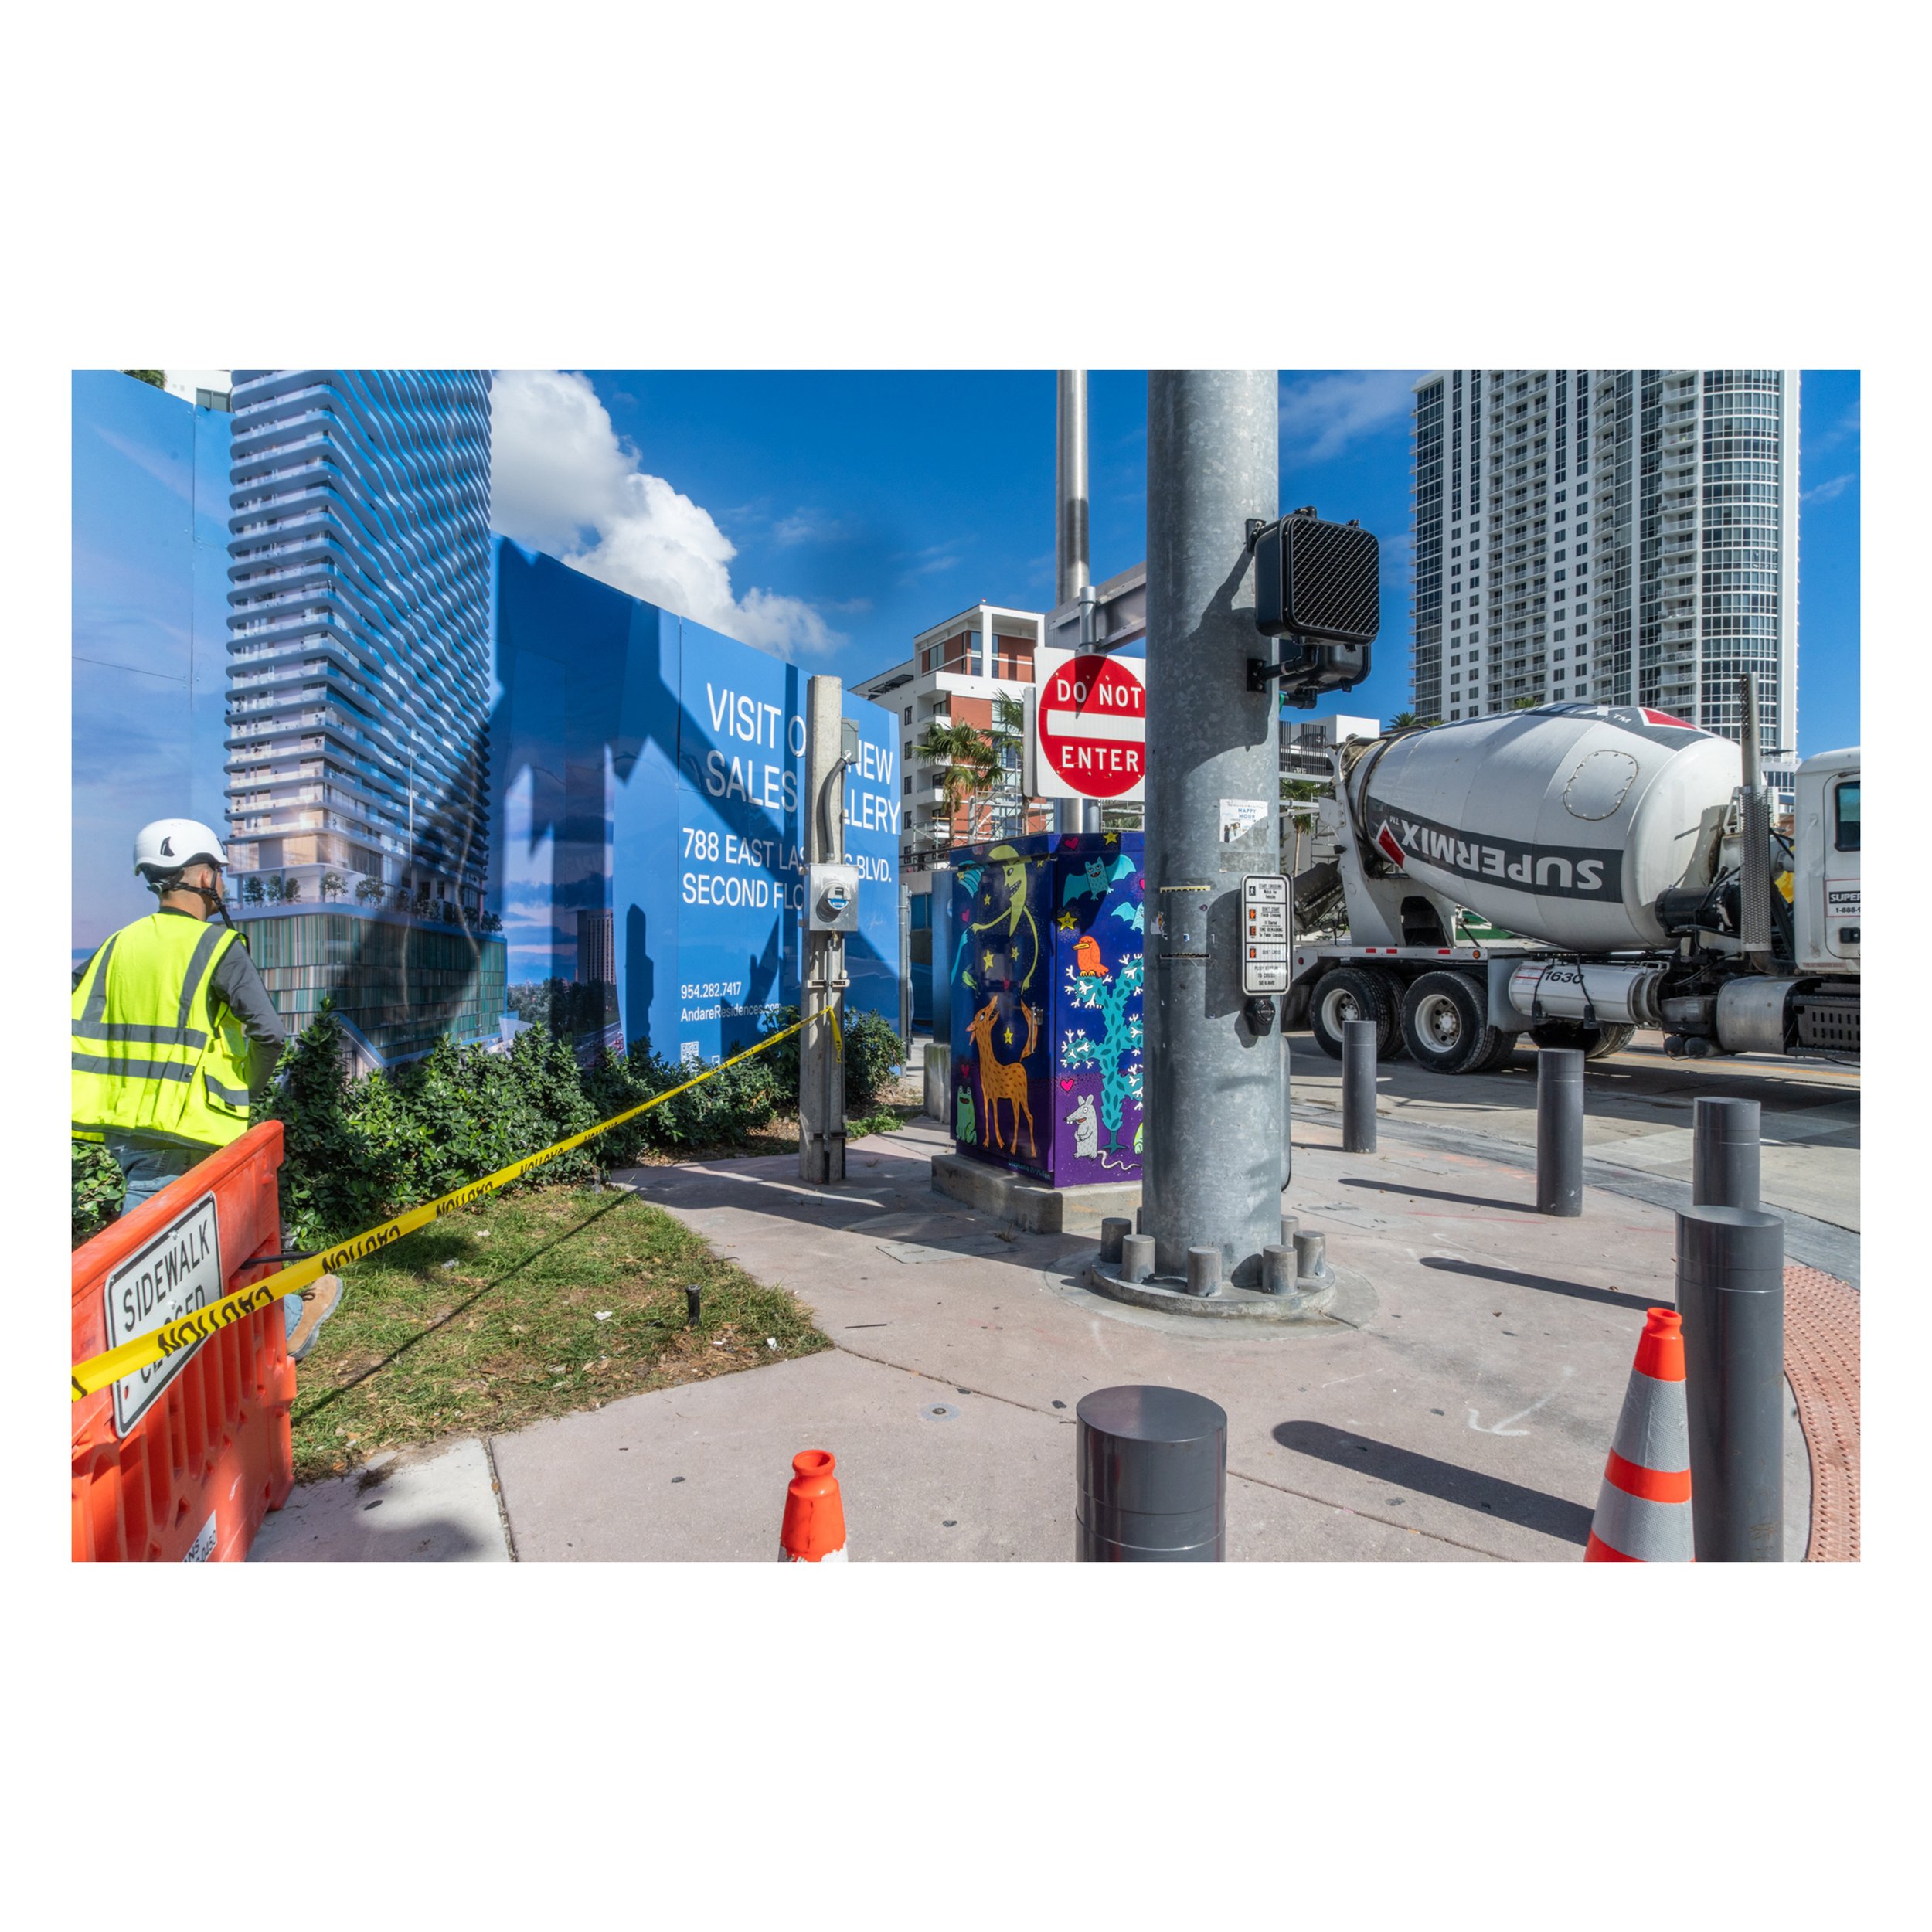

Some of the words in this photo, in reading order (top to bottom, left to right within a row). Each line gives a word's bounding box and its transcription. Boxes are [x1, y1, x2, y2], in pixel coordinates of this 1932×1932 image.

[706, 682, 781, 749] VISIT
[1056, 679, 1087, 703] DO
[1099, 683, 1142, 709] NOT
[1062, 745, 1139, 773] ENTER
[706, 750, 798, 812] SALES
[844, 788, 901, 835] LERY
[682, 828, 719, 862] 788
[726, 835, 774, 867] EAST
[857, 855, 892, 883] BLVD.
[1400, 819, 1604, 890] SUPERMIX
[682, 872, 768, 908] SECOND
[774, 881, 804, 910] FLO
[681, 981, 742, 1000] 954.282.7417
[1545, 971, 1585, 985] 1630
[436, 1180, 493, 1219] CAUTION
[321, 1224, 402, 1274] CAUTION
[122, 1219, 211, 1333] SIDEWALK
[157, 1284, 275, 1358] CAUTION
